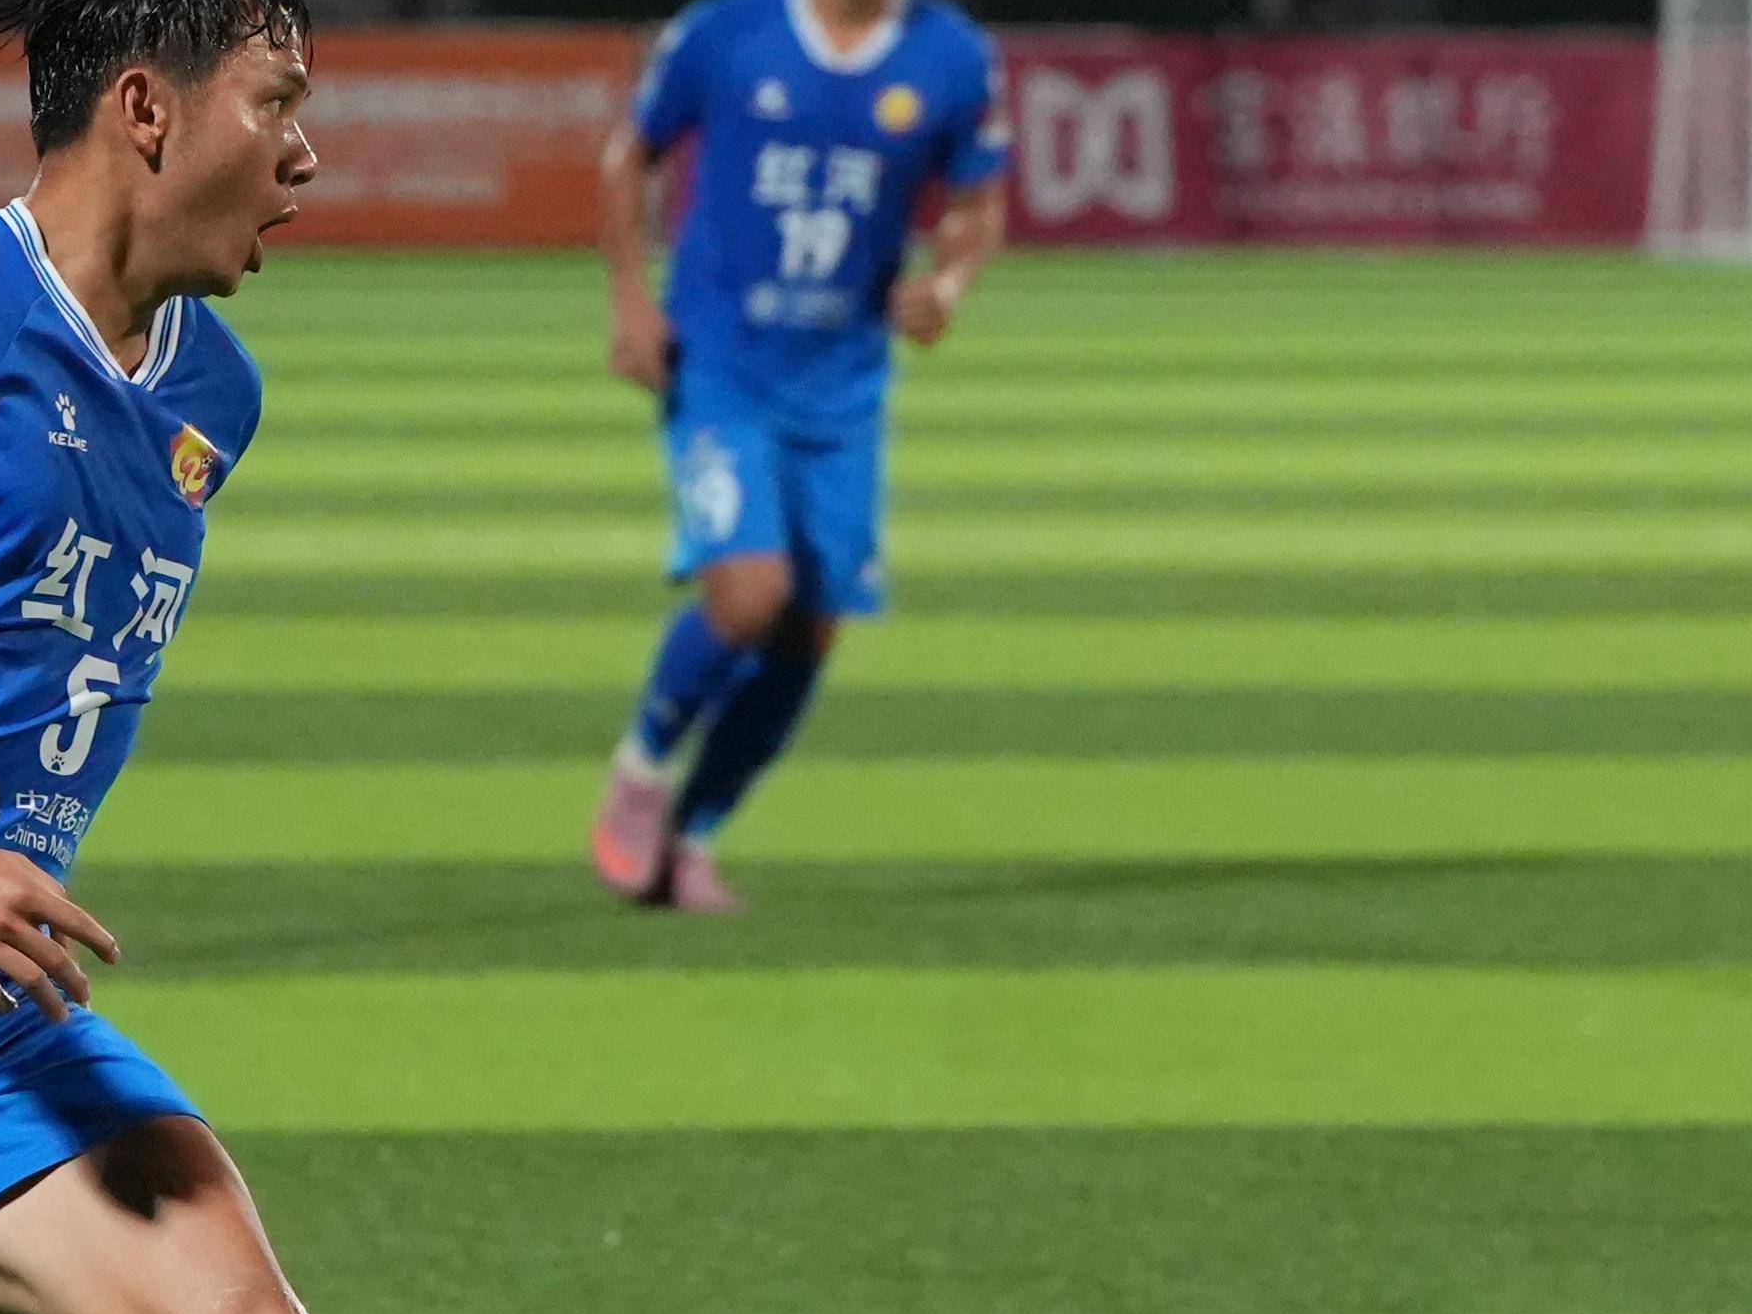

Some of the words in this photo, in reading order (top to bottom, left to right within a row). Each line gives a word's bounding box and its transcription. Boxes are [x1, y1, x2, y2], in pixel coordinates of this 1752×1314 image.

[48, 431, 89, 453] KELME
[21, 517, 194, 665] 红河
[39, 654, 121, 777] 5
